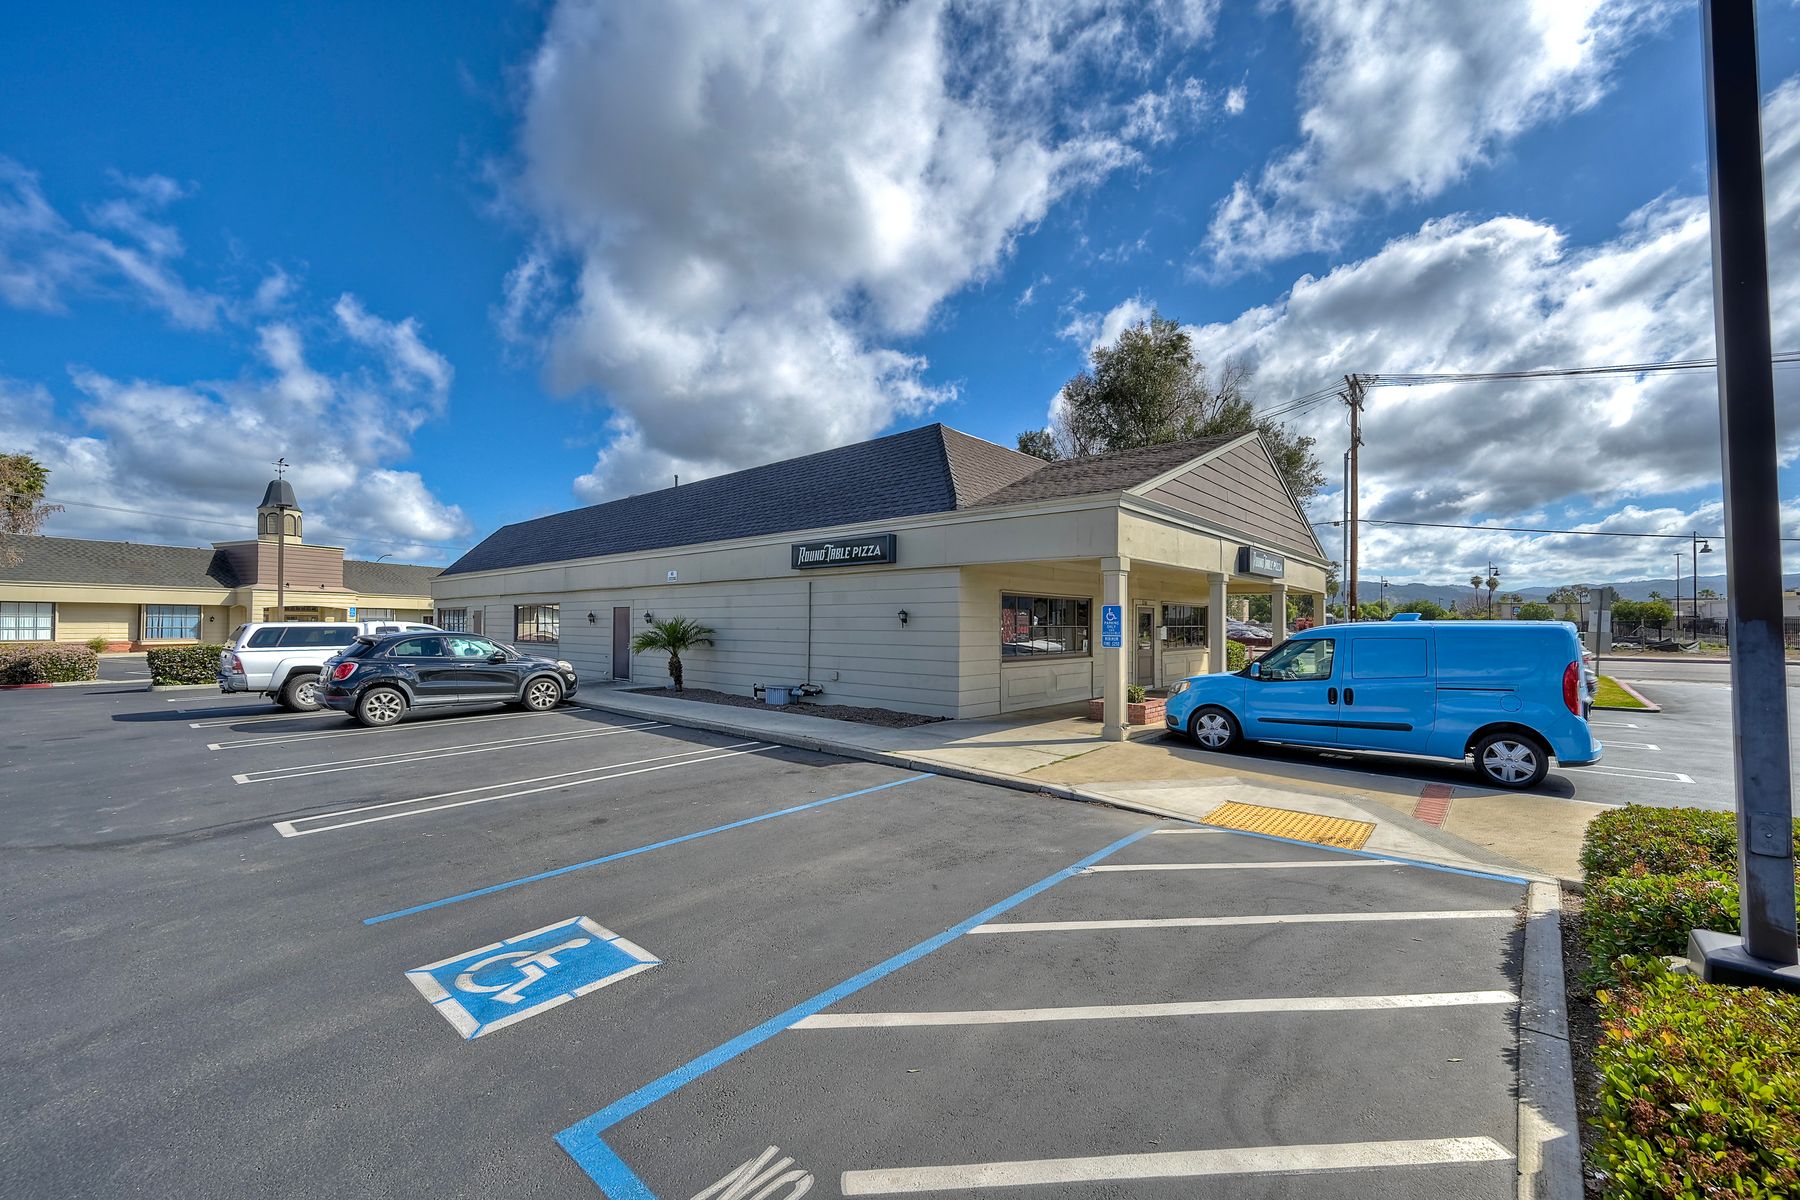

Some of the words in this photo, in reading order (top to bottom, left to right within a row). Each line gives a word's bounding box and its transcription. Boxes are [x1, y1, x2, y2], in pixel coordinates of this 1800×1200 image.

[798, 546, 825, 565] ROUND
[824, 544, 851, 562] TABLE
[852, 544, 881, 558] PIZZA
